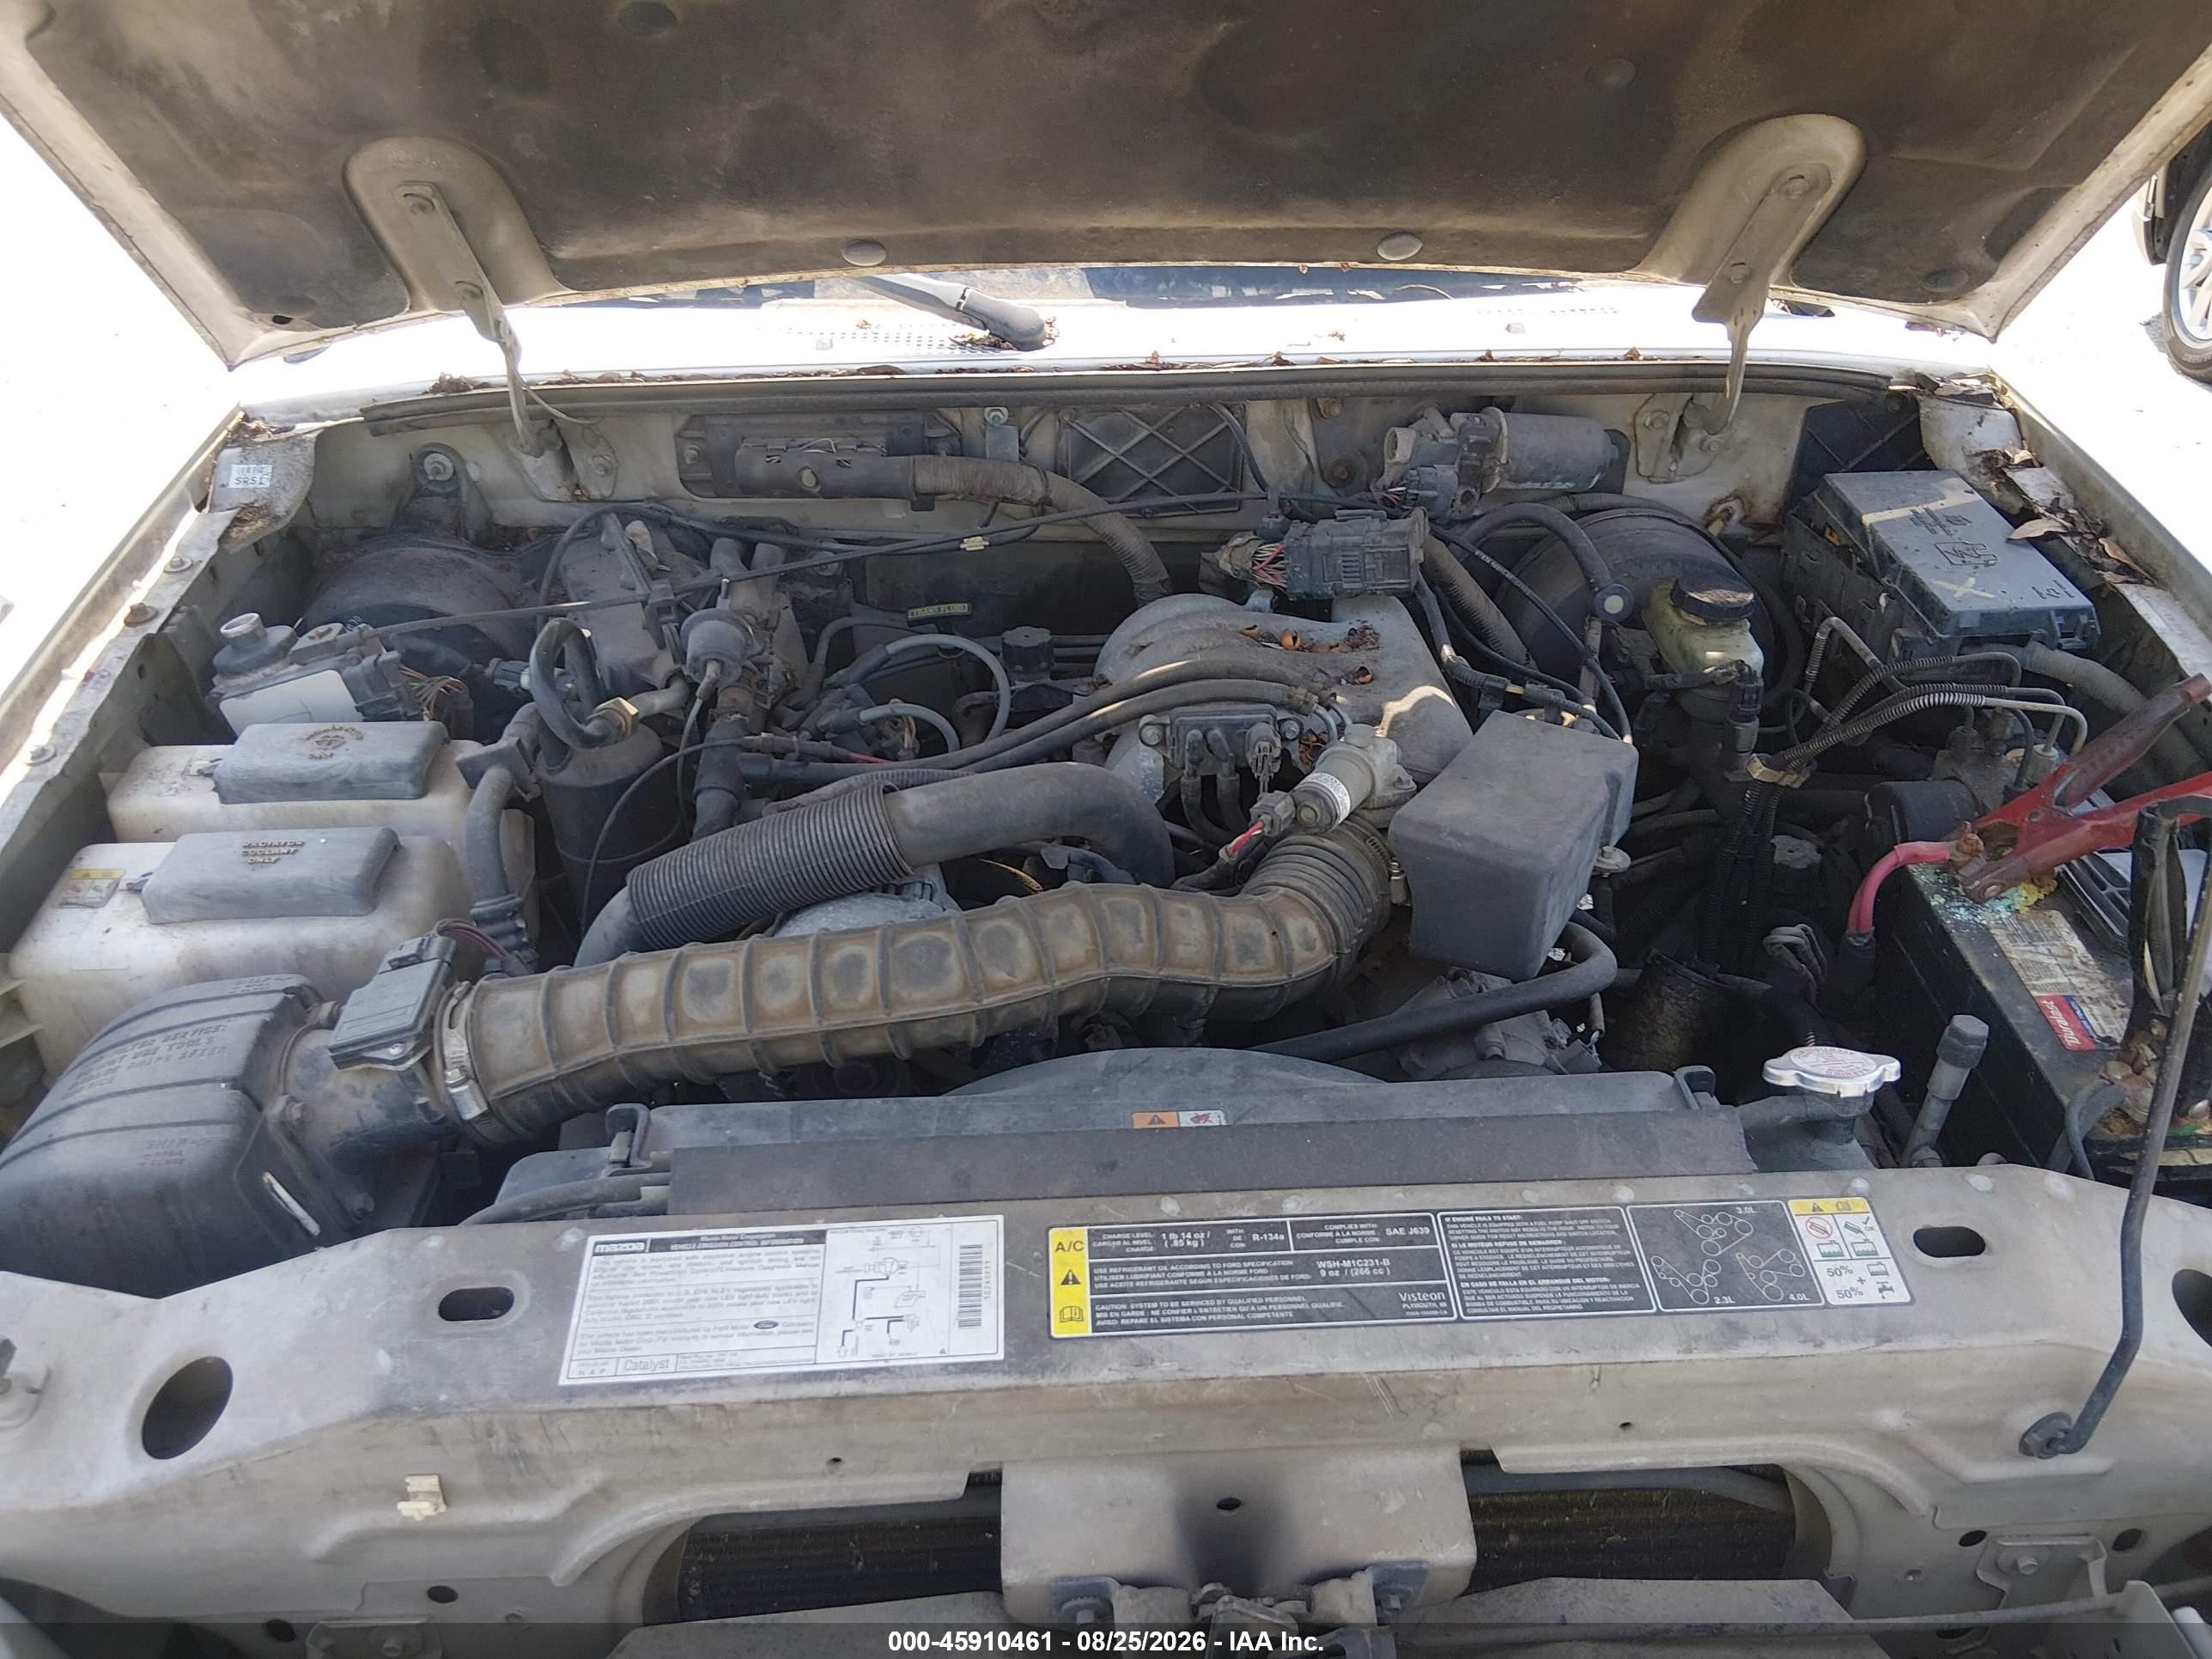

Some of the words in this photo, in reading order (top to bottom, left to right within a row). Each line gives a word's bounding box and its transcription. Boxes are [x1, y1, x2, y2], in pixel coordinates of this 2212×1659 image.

[242, 840, 306, 848] RADIATOR
[2040, 1000, 2081, 1045] Duralast
[1186, 1238, 1198, 1248] kg
[1252, 1233, 1284, 1241] R-134a
[595, 1242, 645, 1253] mazda
[1054, 1240, 1085, 1252] A/C
[1827, 1265, 1854, 1277] 50%
[1399, 1290, 1446, 1302] Visteon
[1836, 1287, 1864, 1299] 50%
[624, 1358, 669, 1372] Catalyst
